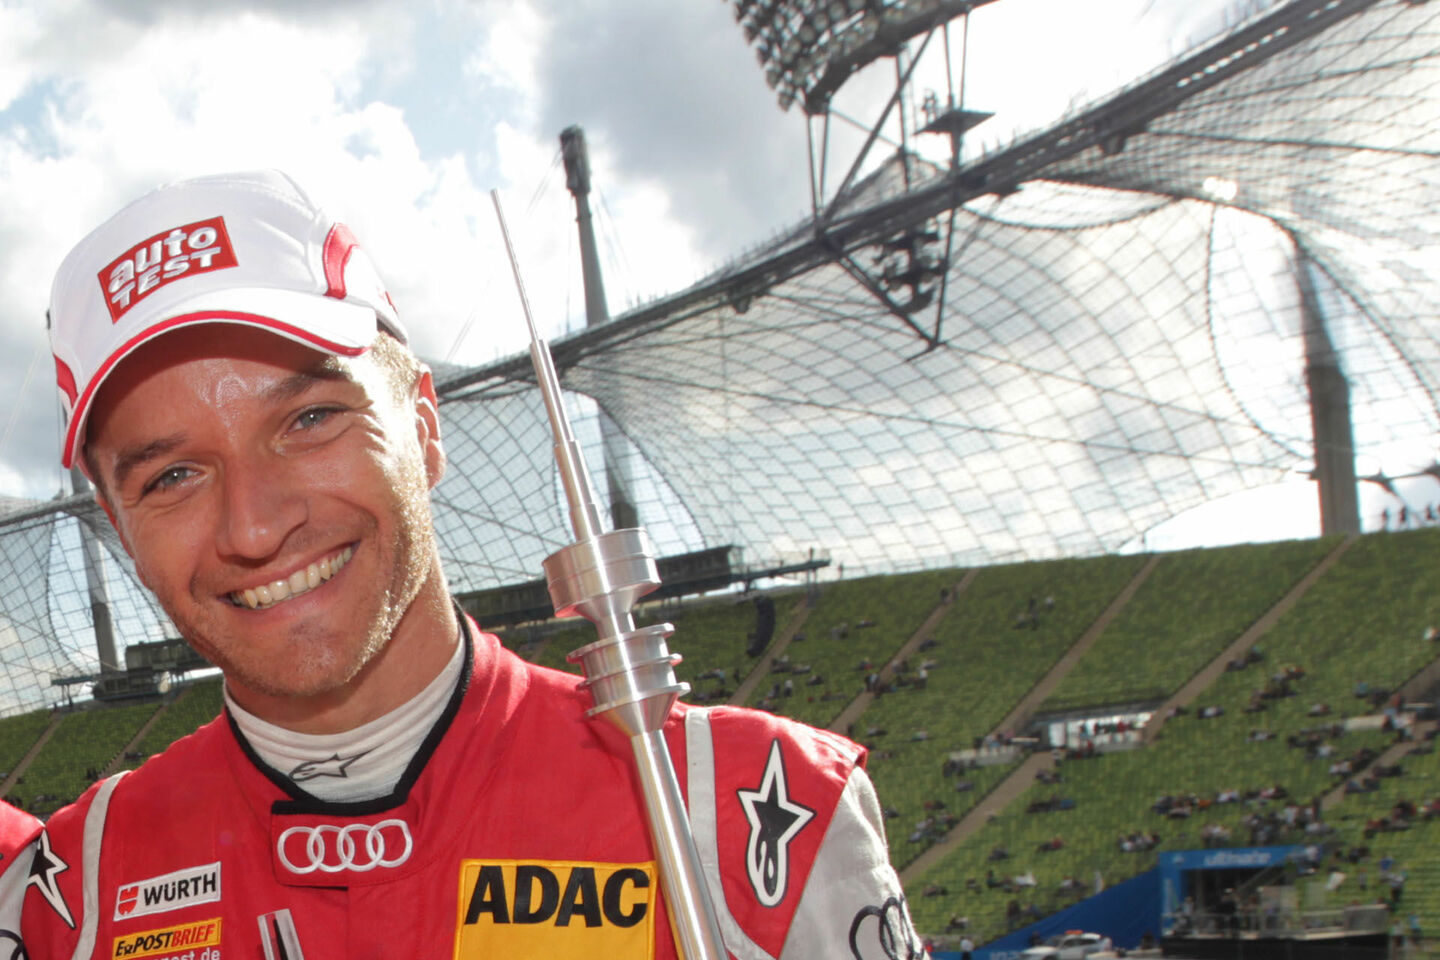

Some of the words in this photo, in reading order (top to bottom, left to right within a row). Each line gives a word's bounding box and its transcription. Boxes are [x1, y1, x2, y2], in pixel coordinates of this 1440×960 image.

[109, 226, 218, 293] auto
[111, 246, 222, 309] TEST
[144, 871, 217, 906] WÜRTH
[464, 865, 650, 928] ADAC
